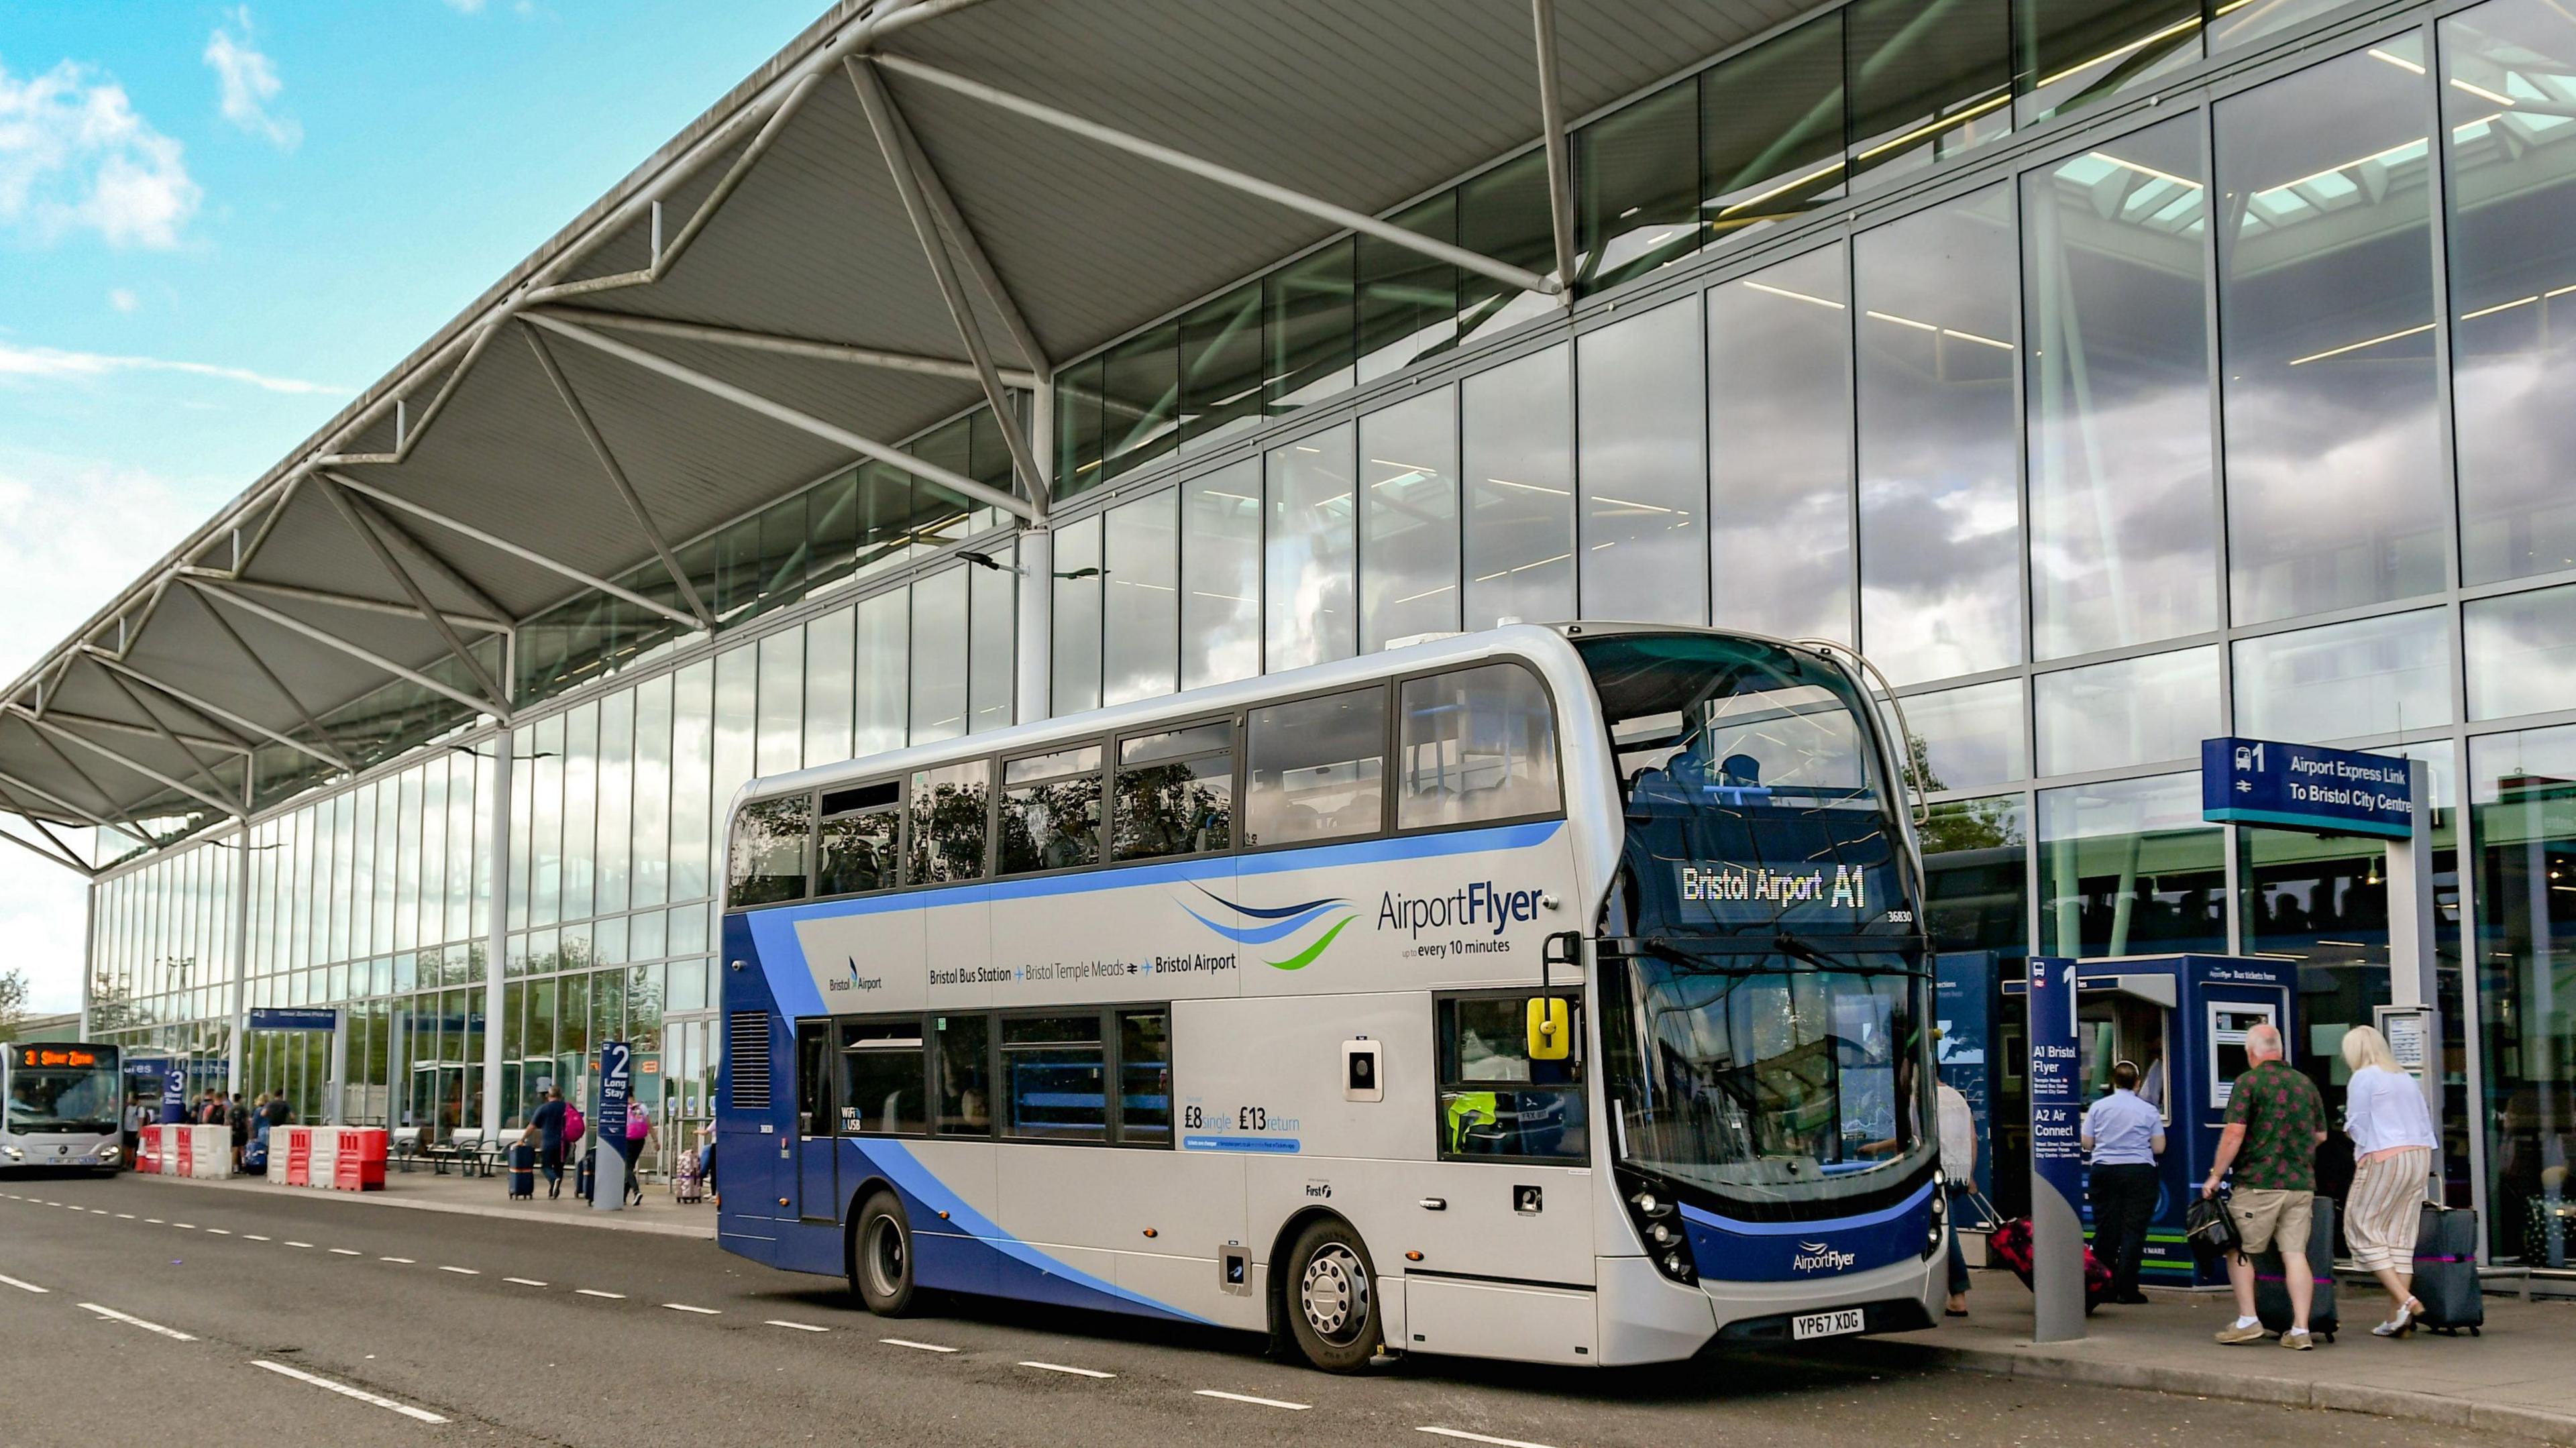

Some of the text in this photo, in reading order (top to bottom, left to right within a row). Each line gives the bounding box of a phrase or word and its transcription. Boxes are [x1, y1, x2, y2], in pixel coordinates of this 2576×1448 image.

[2252, 743, 2406, 785] 1 Airport Express Link
[2290, 783, 2412, 813] To Bristol City Centre
[1682, 864, 1864, 908] Bristol Airport A1
[1377, 881, 1543, 940] AirportFlyer
[1887, 911, 1913, 923] 36830
[1418, 944, 1446, 959] every
[1449, 940, 1462, 954] 10
[1465, 940, 1510, 954] minutes
[930, 953, 1236, 985] Bristol Bus Station Bristol Temple Meads Bristol Airport
[2234, 970, 2245, 979] Bus
[2245, 971, 2263, 980] tickets
[829, 977, 881, 993] Bristol Airport
[2063, 965, 2078, 1038] 1
[25, 1050, 37, 1066] 3
[68, 1050, 95, 1066] Zone
[2033, 1046, 2076, 1058] A1 Bristol
[610, 1045, 629, 1078] 2
[2033, 1060, 2059, 1075] Flyer
[170, 1070, 183, 1092] 3
[604, 1078, 626, 1089] Long
[604, 1089, 625, 1099] Stay
[2035, 1109, 2066, 1121] A2 Air
[847, 1119, 861, 1131] USB
[2035, 1124, 2074, 1136] Connect
[1306, 1184, 1322, 1196] First
[1793, 1250, 1855, 1273] AirportFlyer
[1799, 1312, 1858, 1335] YP67 XDG
